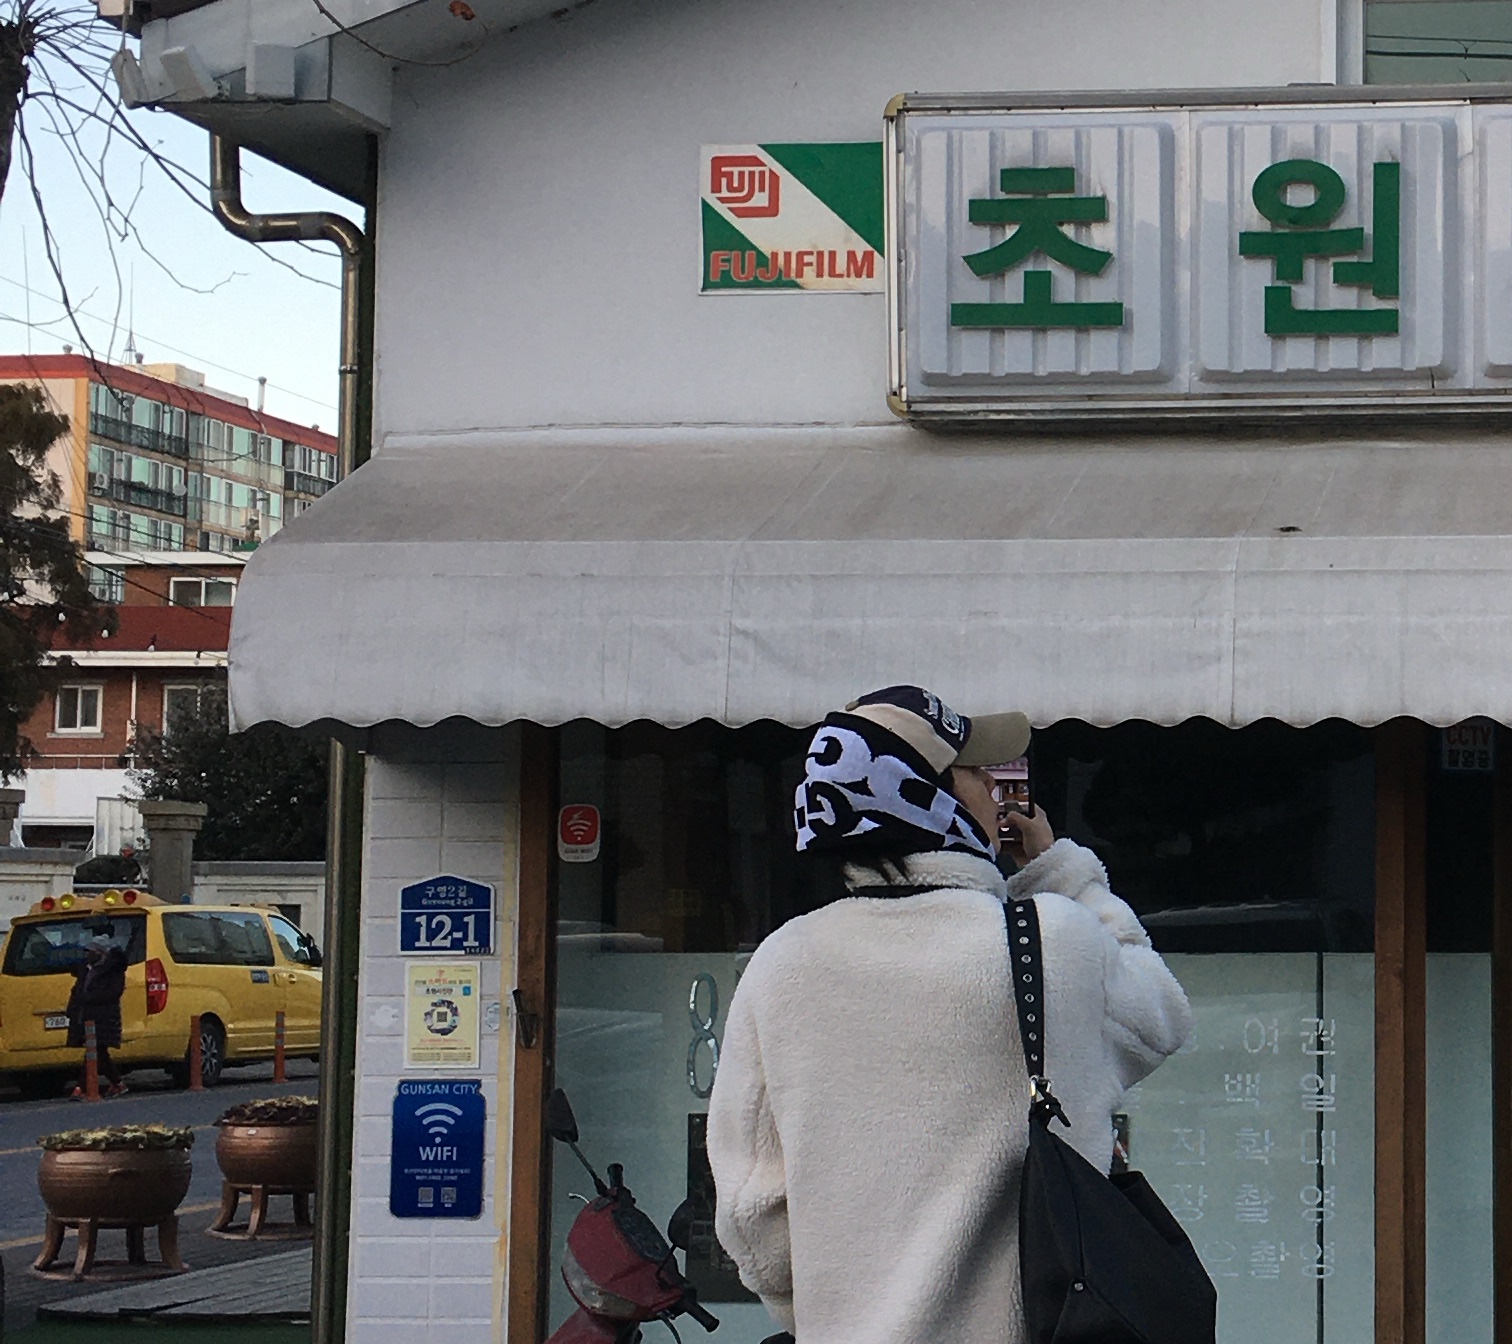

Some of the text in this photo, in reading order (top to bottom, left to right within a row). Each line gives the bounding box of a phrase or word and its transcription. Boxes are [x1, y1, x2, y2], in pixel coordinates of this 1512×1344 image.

[711, 158, 776, 212] FUJI
[710, 249, 875, 282] FUJIFILM
[1447, 726, 1491, 745] CCTV
[425, 885, 467, 898] 구영2길
[415, 914, 479, 947] 12-1
[401, 1082, 478, 1095] GUNSAN CITY
[419, 1146, 457, 1161] WIFI
